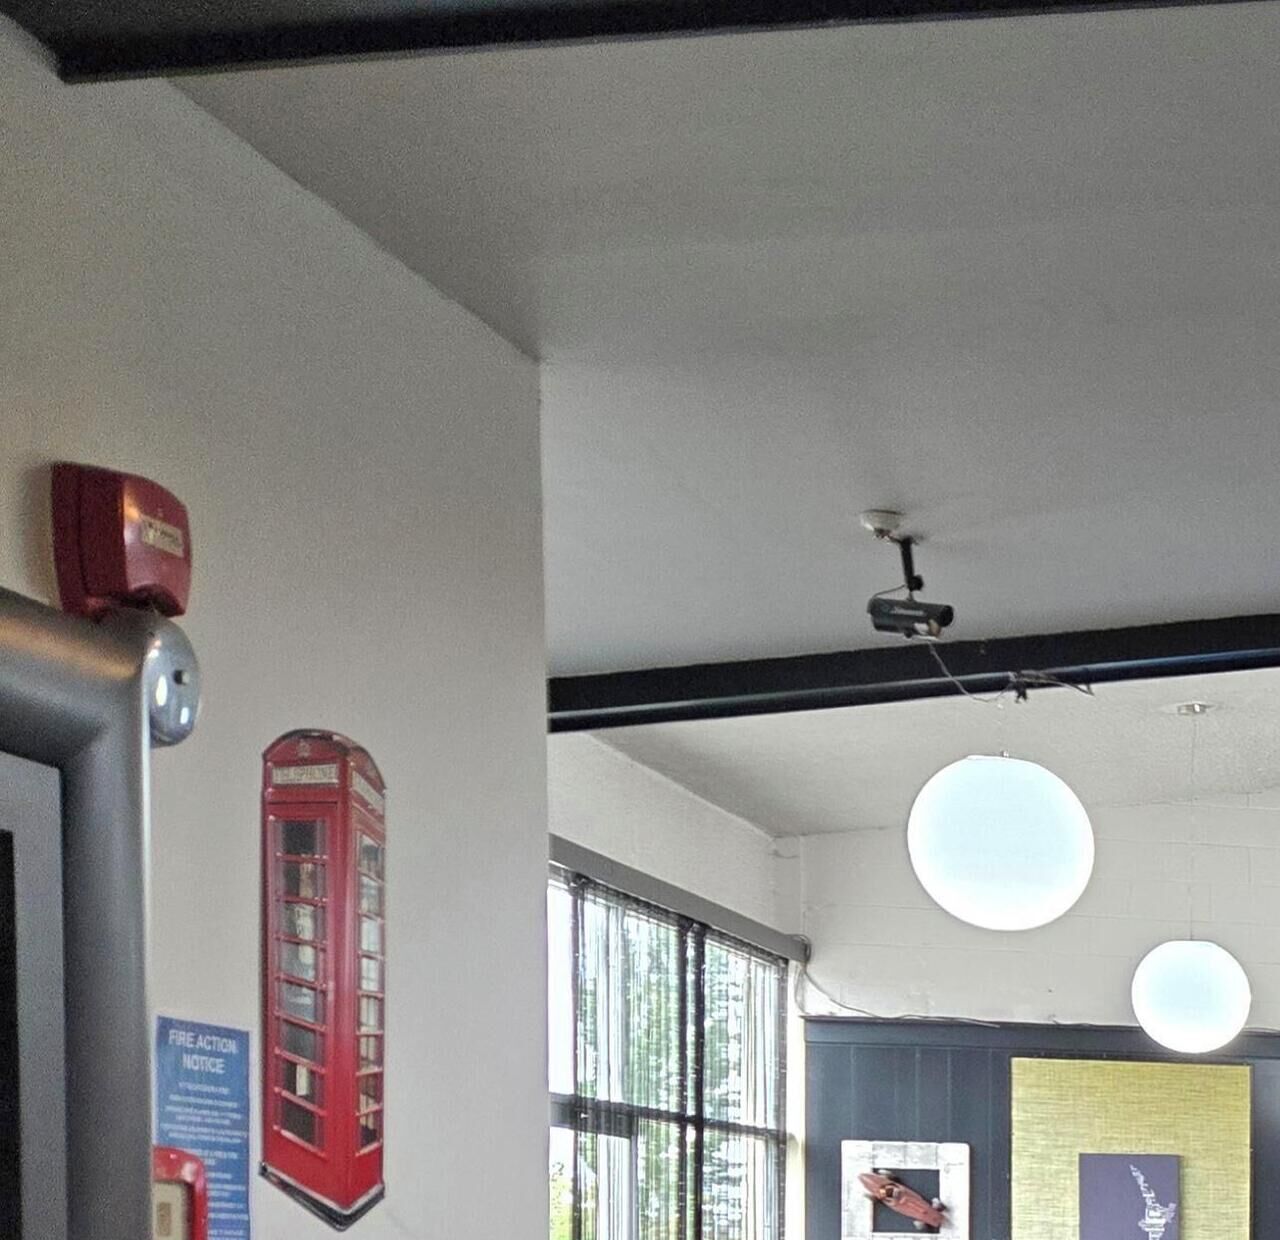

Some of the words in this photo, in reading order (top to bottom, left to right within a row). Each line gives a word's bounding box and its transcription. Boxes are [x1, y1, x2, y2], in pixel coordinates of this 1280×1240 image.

[168, 1029, 194, 1048] FIRE
[196, 1034, 238, 1054] ACTION
[182, 1053, 225, 1074] NOTICE
